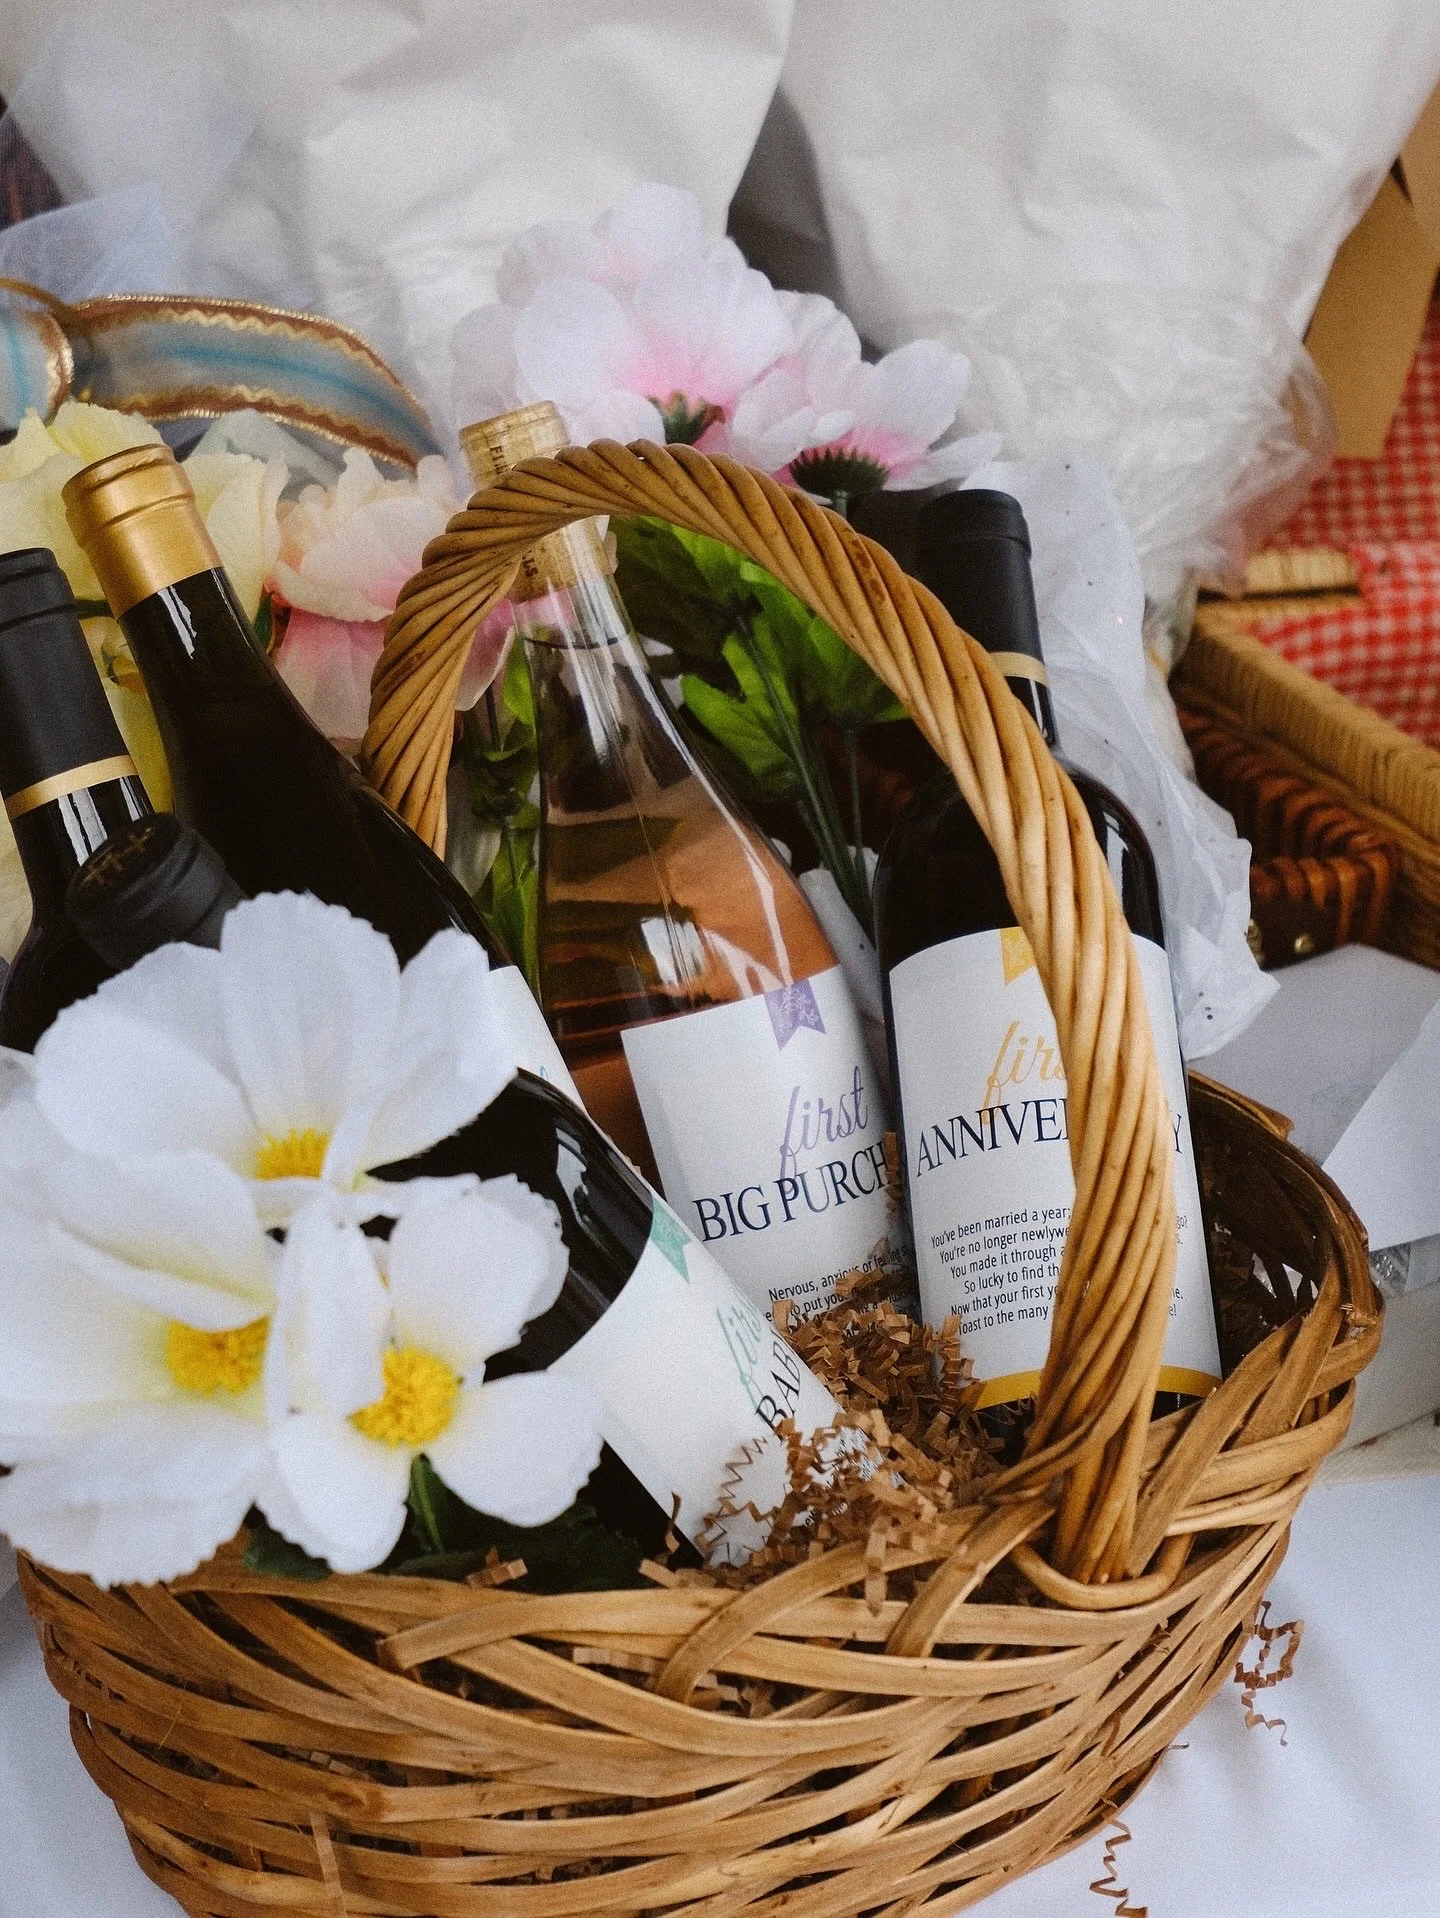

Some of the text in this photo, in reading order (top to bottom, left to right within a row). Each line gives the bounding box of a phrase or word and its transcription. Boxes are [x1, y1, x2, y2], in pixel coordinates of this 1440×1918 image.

[982, 1020, 1067, 1125] fir
[779, 1065, 868, 1194] first
[916, 1097, 1182, 1177] ANNIVEY
[692, 1140, 890, 1243] BIG PURCH
[930, 1229, 955, 1249] You've
[957, 1221, 982, 1238] been
[984, 1208, 1028, 1230] married
[1031, 1210, 1039, 1222] a
[1041, 1207, 1071, 1225] year;
[939, 1225, 1069, 1264] You're no longer newlywe
[768, 1281, 819, 1302] Nervous,
[862, 1260, 872, 1274] or
[950, 1266, 967, 1280] You
[969, 1254, 997, 1273] made
[1000, 1252, 1008, 1268] it
[1010, 1244, 1057, 1263] through
[964, 1263, 1060, 1295] So lucky to find th
[803, 1297, 823, 1314] put
[824, 1293, 849, 1311] you
[950, 1301, 971, 1317] Now
[972, 1295, 992, 1312] that
[994, 1290, 1019, 1310] your
[1021, 1285, 1045, 1300] first
[984, 1314, 994, 1328] to
[996, 1310, 1014, 1324] the
[1017, 1304, 1049, 1321] many
